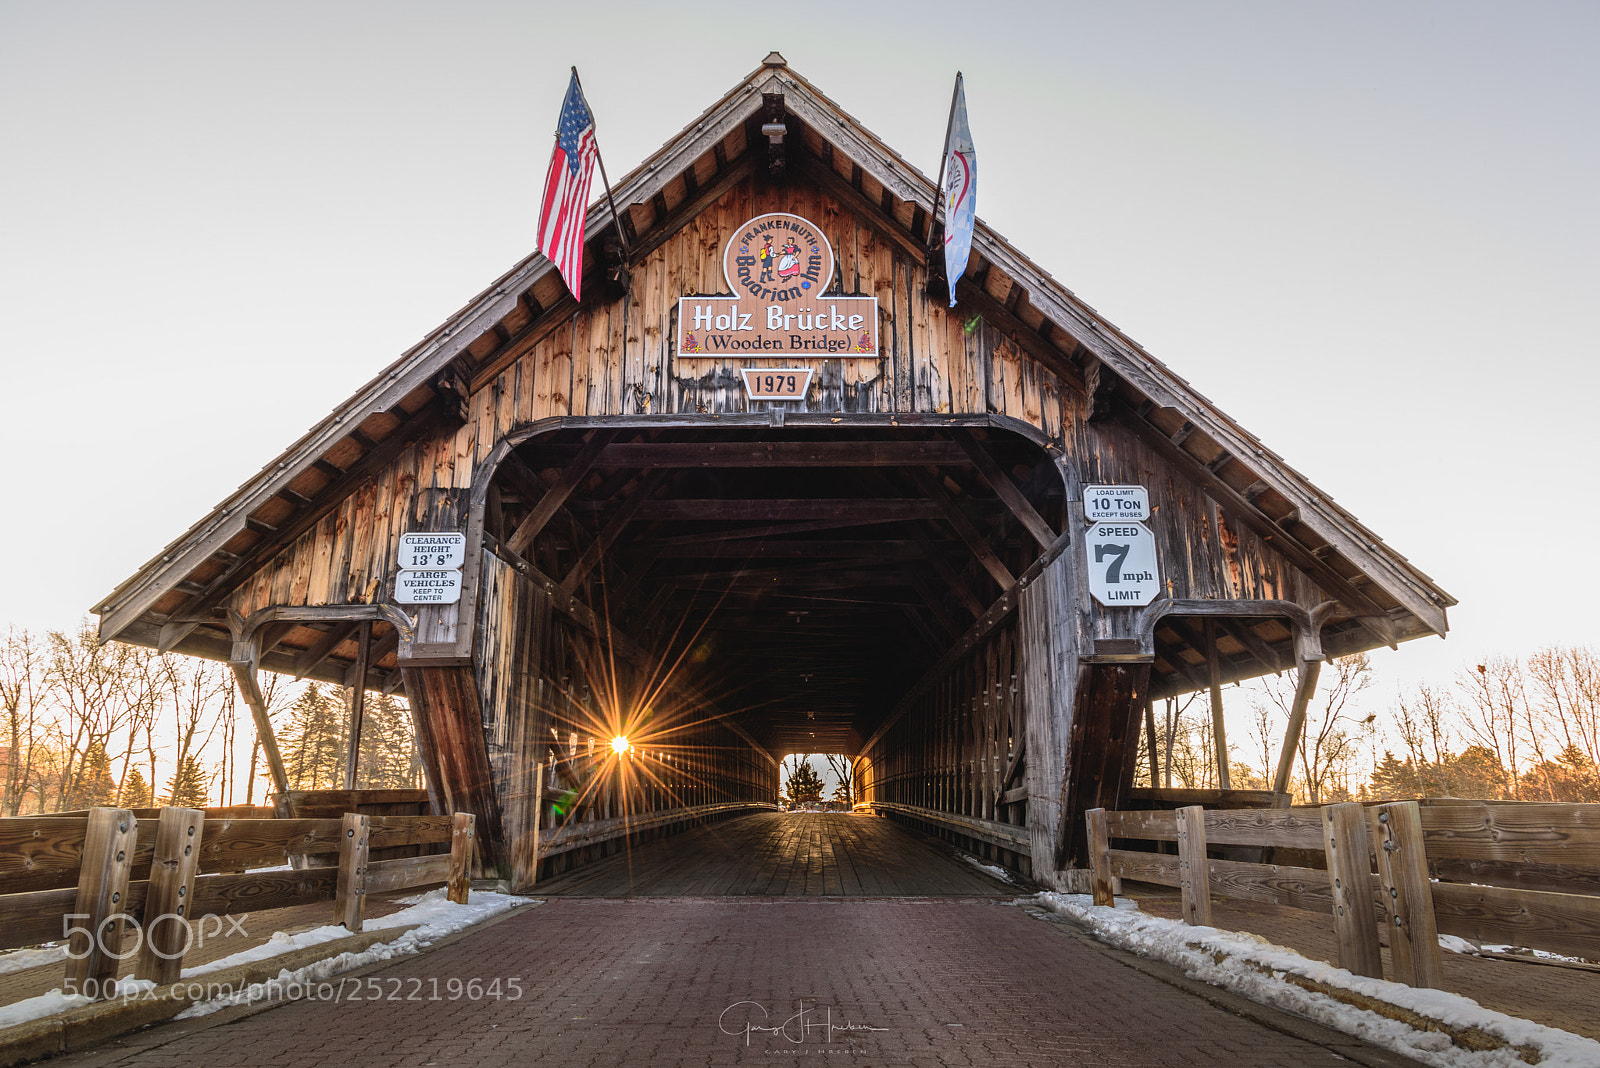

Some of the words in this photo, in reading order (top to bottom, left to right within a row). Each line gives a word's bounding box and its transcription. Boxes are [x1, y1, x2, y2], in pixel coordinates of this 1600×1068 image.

[741, 220, 818, 246] FRANKENMUTH
[735, 255, 802, 302] Bavarian
[800, 254, 822, 283] Inn
[692, 304, 754, 332] Holz
[765, 304, 865, 332] Brücke
[704, 334, 783, 351] (Wooden
[788, 334, 852, 352] Bridge)
[755, 375, 796, 393] 1979
[1092, 498, 1111, 510] 10
[405, 537, 461, 545] CLEARANCE
[1098, 527, 1139, 537] SPEED
[1094, 543, 1130, 584] 7
[1122, 571, 1154, 583] mph
[1107, 590, 1141, 600] LIMIT
